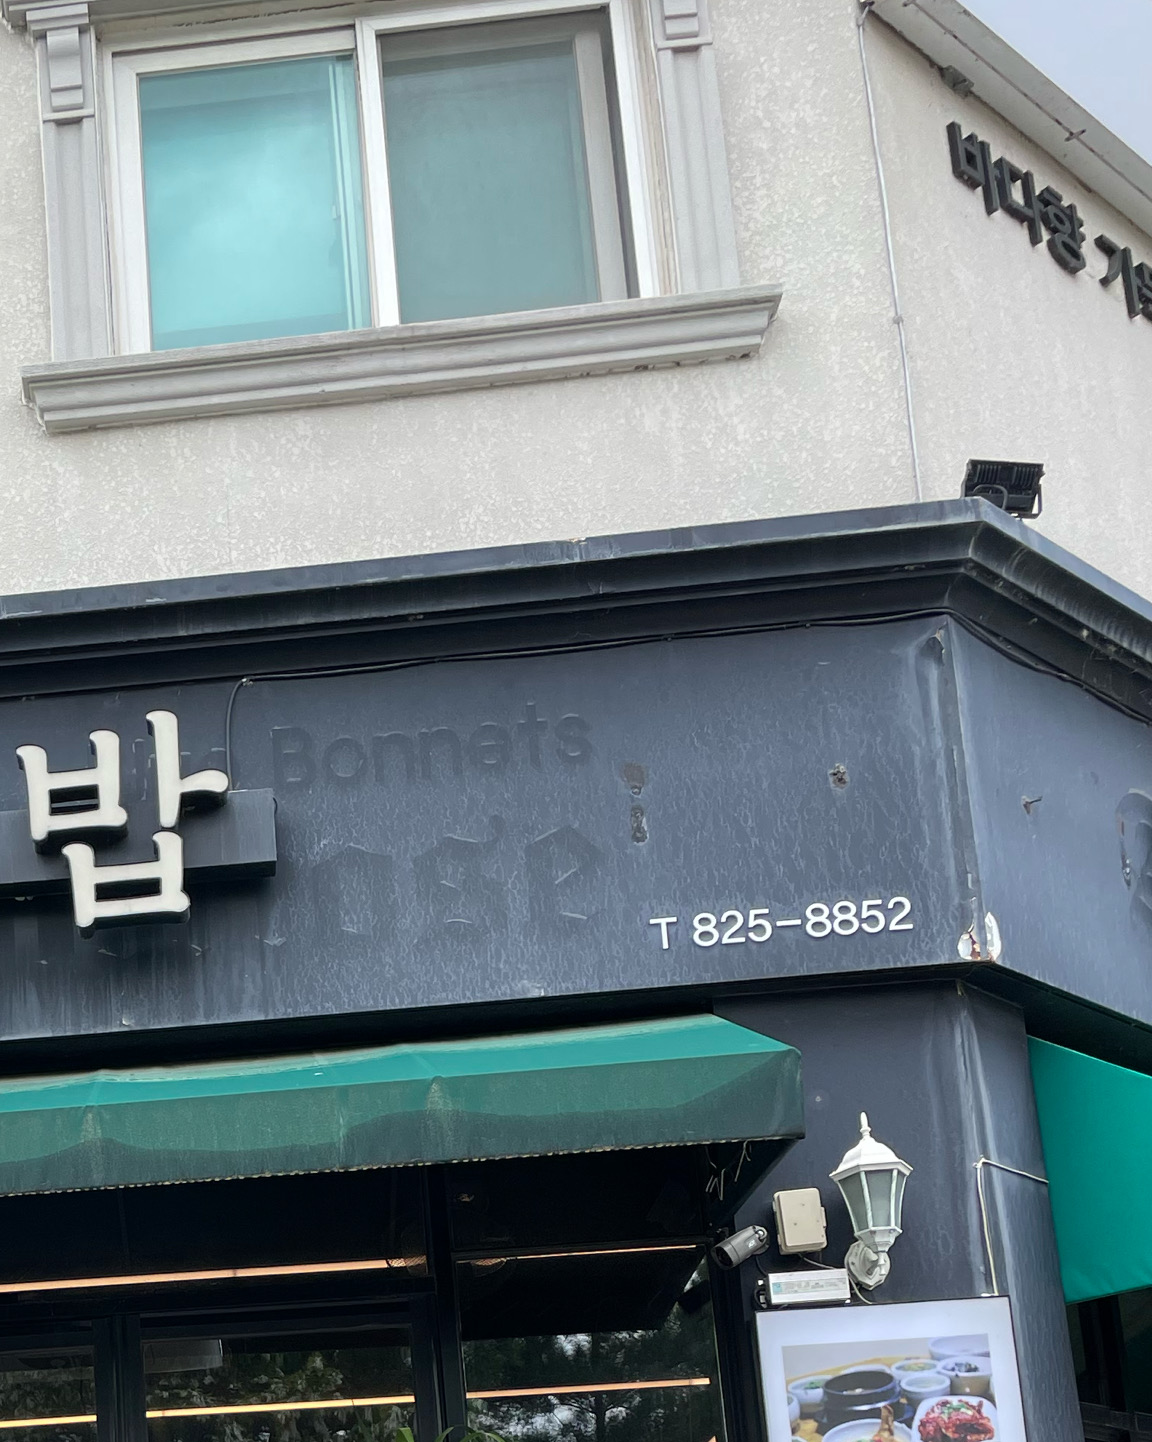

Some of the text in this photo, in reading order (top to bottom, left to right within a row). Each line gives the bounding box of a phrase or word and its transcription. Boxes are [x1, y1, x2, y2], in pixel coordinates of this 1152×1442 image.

[946, 121, 1087, 275] 바다향
[649, 896, 914, 950] T 825-8852
